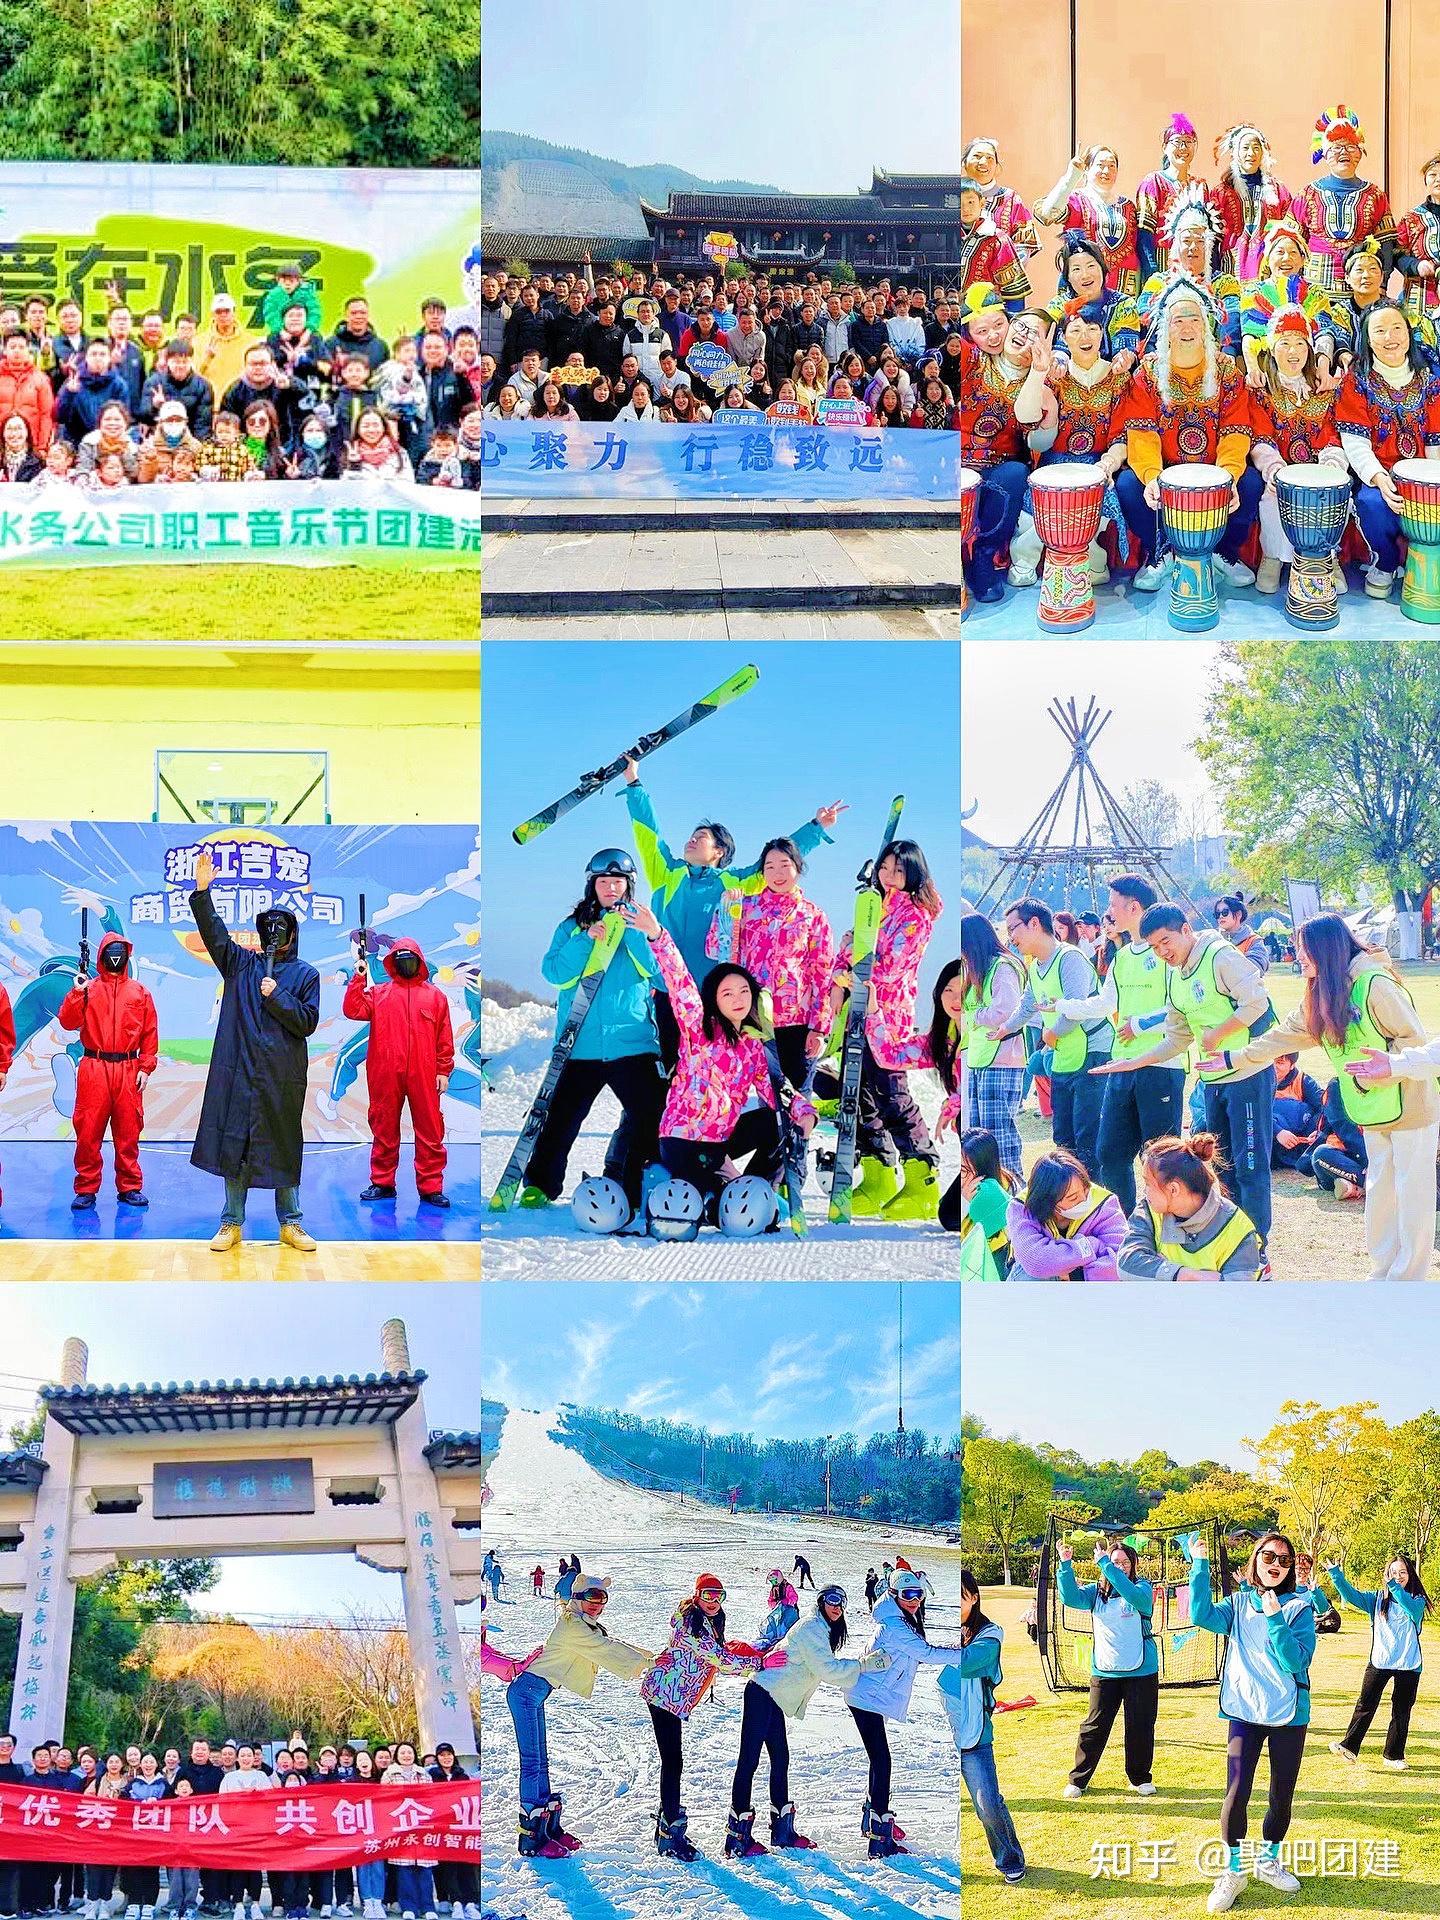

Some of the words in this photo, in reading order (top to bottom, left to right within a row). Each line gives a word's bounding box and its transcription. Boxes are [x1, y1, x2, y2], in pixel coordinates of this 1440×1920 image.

[481, 431, 628, 471] 心聚力
[680, 432, 884, 474] 行稳致远
[166, 843, 311, 883] 浙江吉宠
[130, 888, 345, 925] 商贸有限公司
[0, 1794, 231, 1836] 优秀团队
[275, 1796, 481, 1836] 共创企业
